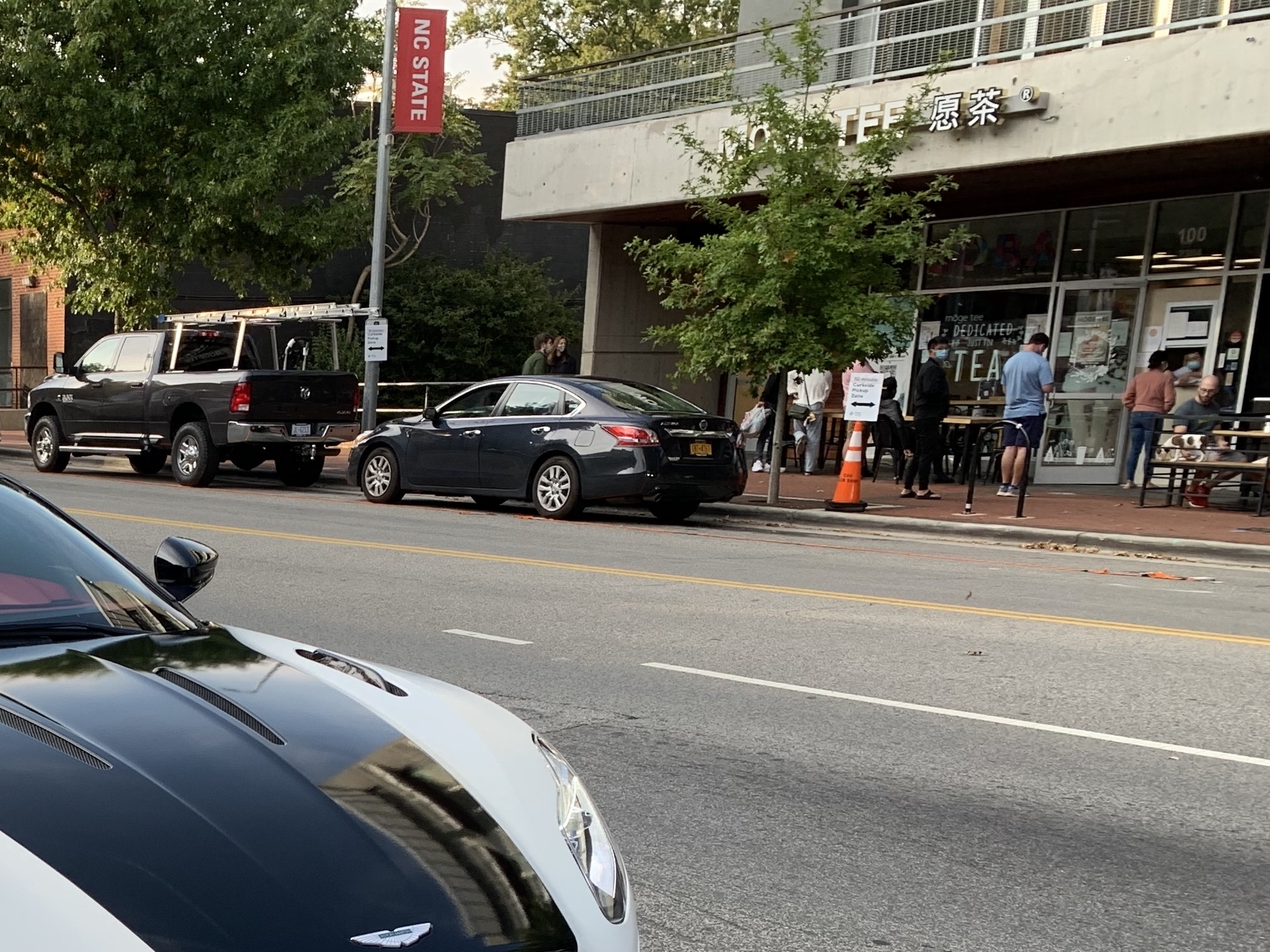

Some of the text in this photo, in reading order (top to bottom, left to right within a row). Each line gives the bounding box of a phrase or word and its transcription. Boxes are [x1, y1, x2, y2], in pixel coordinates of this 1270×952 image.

[410, 19, 431, 121] NC STATE
[929, 87, 1002, 133] 愿茶
[1178, 226, 1207, 244] 100
[953, 323, 1013, 337] DEDICATED
[954, 349, 1002, 382] TEA
